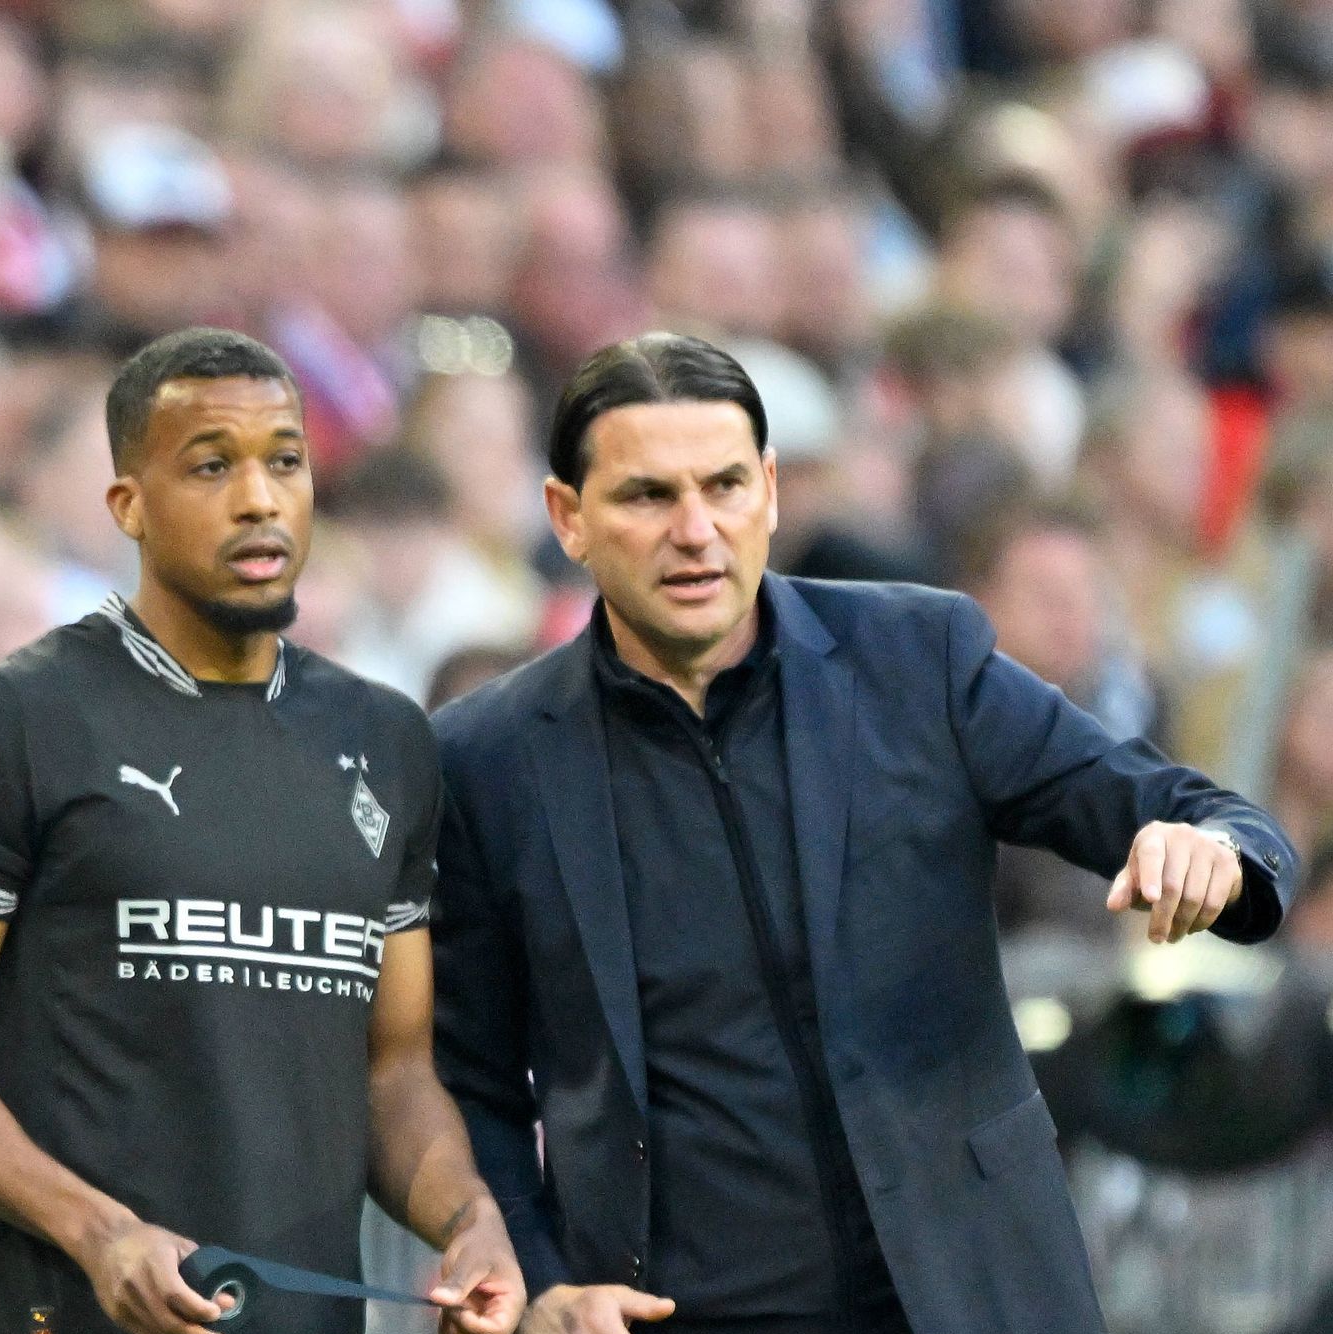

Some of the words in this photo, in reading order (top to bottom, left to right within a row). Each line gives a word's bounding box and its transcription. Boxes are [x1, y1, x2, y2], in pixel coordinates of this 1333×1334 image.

[117, 898, 387, 965] REUTER
[117, 959, 236, 984] BÄDER
[257, 969, 376, 1003] LEUCHTN
